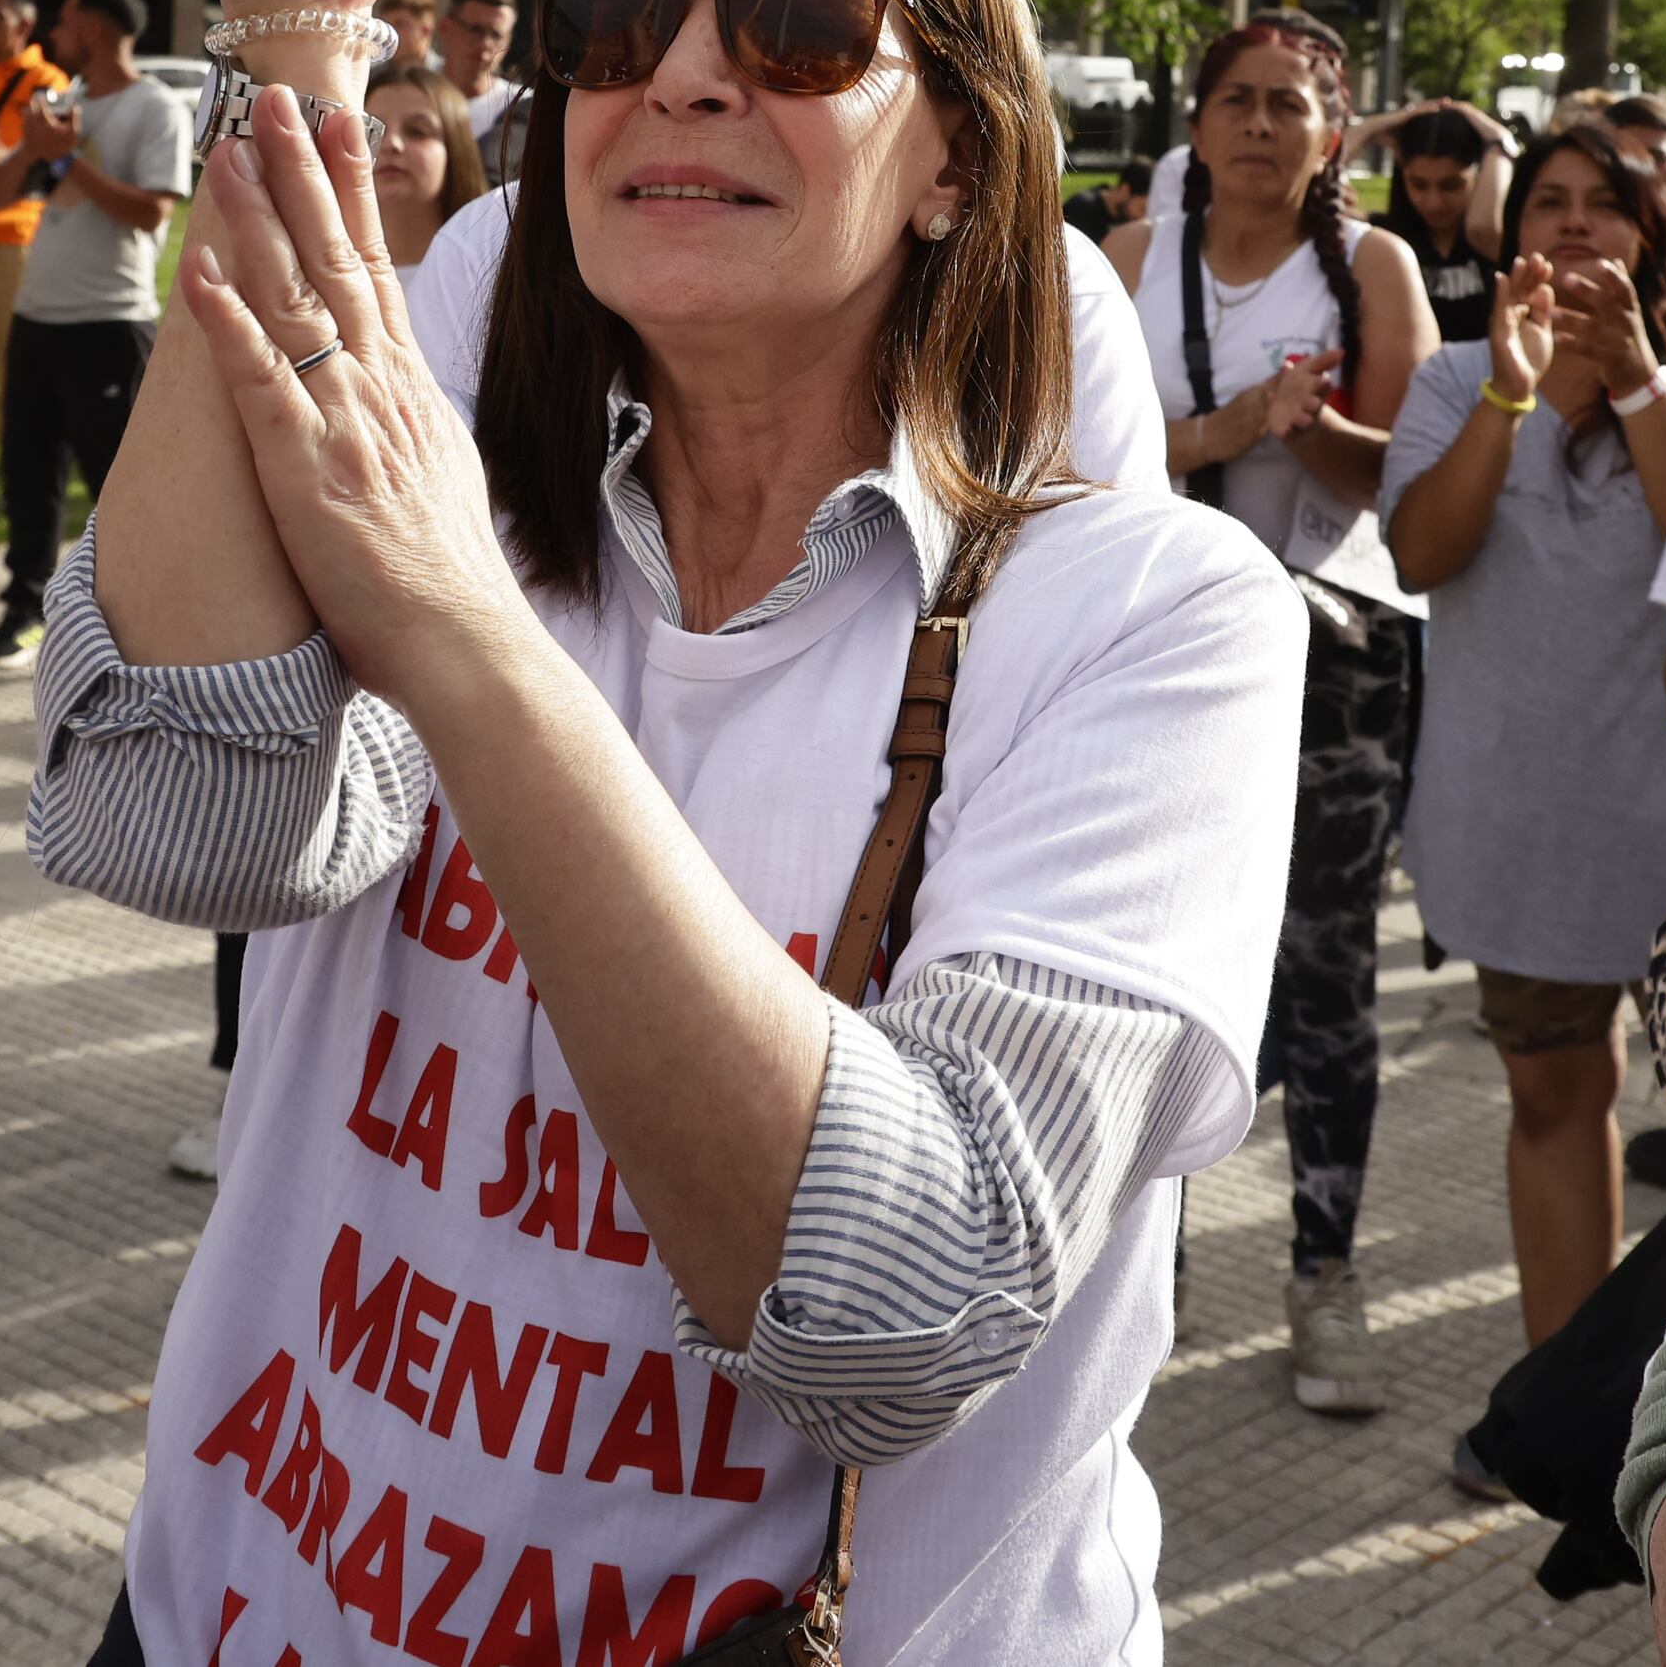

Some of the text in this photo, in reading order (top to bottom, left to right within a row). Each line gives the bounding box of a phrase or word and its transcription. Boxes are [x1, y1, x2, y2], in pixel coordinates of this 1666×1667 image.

[345, 1009, 651, 1268] LA SAL
[318, 1223, 766, 1503] MENTAL
[193, 1347, 819, 1667] ABRAZAM
